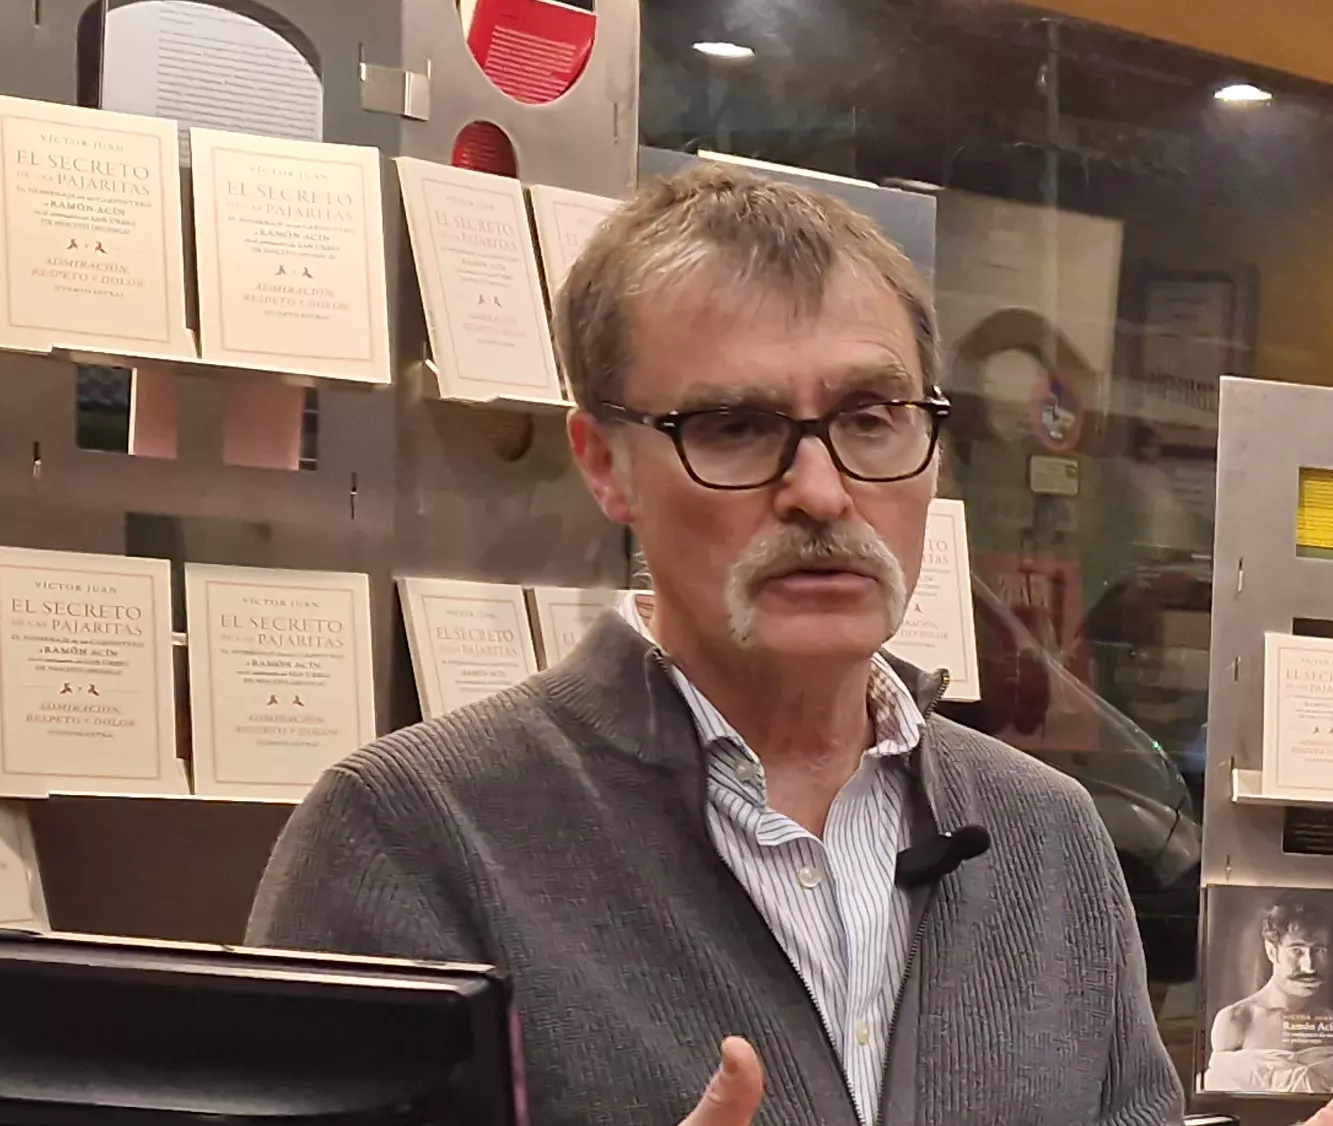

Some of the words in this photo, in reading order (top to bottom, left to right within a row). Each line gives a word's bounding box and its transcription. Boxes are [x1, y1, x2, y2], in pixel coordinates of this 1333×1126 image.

[16, 150, 41, 166] EL
[48, 153, 149, 181] SECRETO
[58, 173, 150, 196] PAJARITAS
[227, 180, 249, 197] EL
[257, 185, 353, 207] SECRETO
[266, 203, 353, 222] PAJARITAS
[453, 216, 513, 236] SECRETO
[34, 580, 82, 592] VÍCTOR
[87, 584, 117, 593] JUAN
[11, 598, 36, 614] EL
[42, 601, 142, 621] SECRETO
[52, 619, 143, 636] PAJARITAS
[220, 614, 243, 628] EL
[250, 617, 343, 633] SECRETO
[258, 633, 344, 648] PAJARITAS
[436, 627, 451, 640] EL
[454, 627, 514, 643] SECRETO
[1286, 669, 1299, 680] EL
[1283, 1022, 1315, 1031] Ramón
